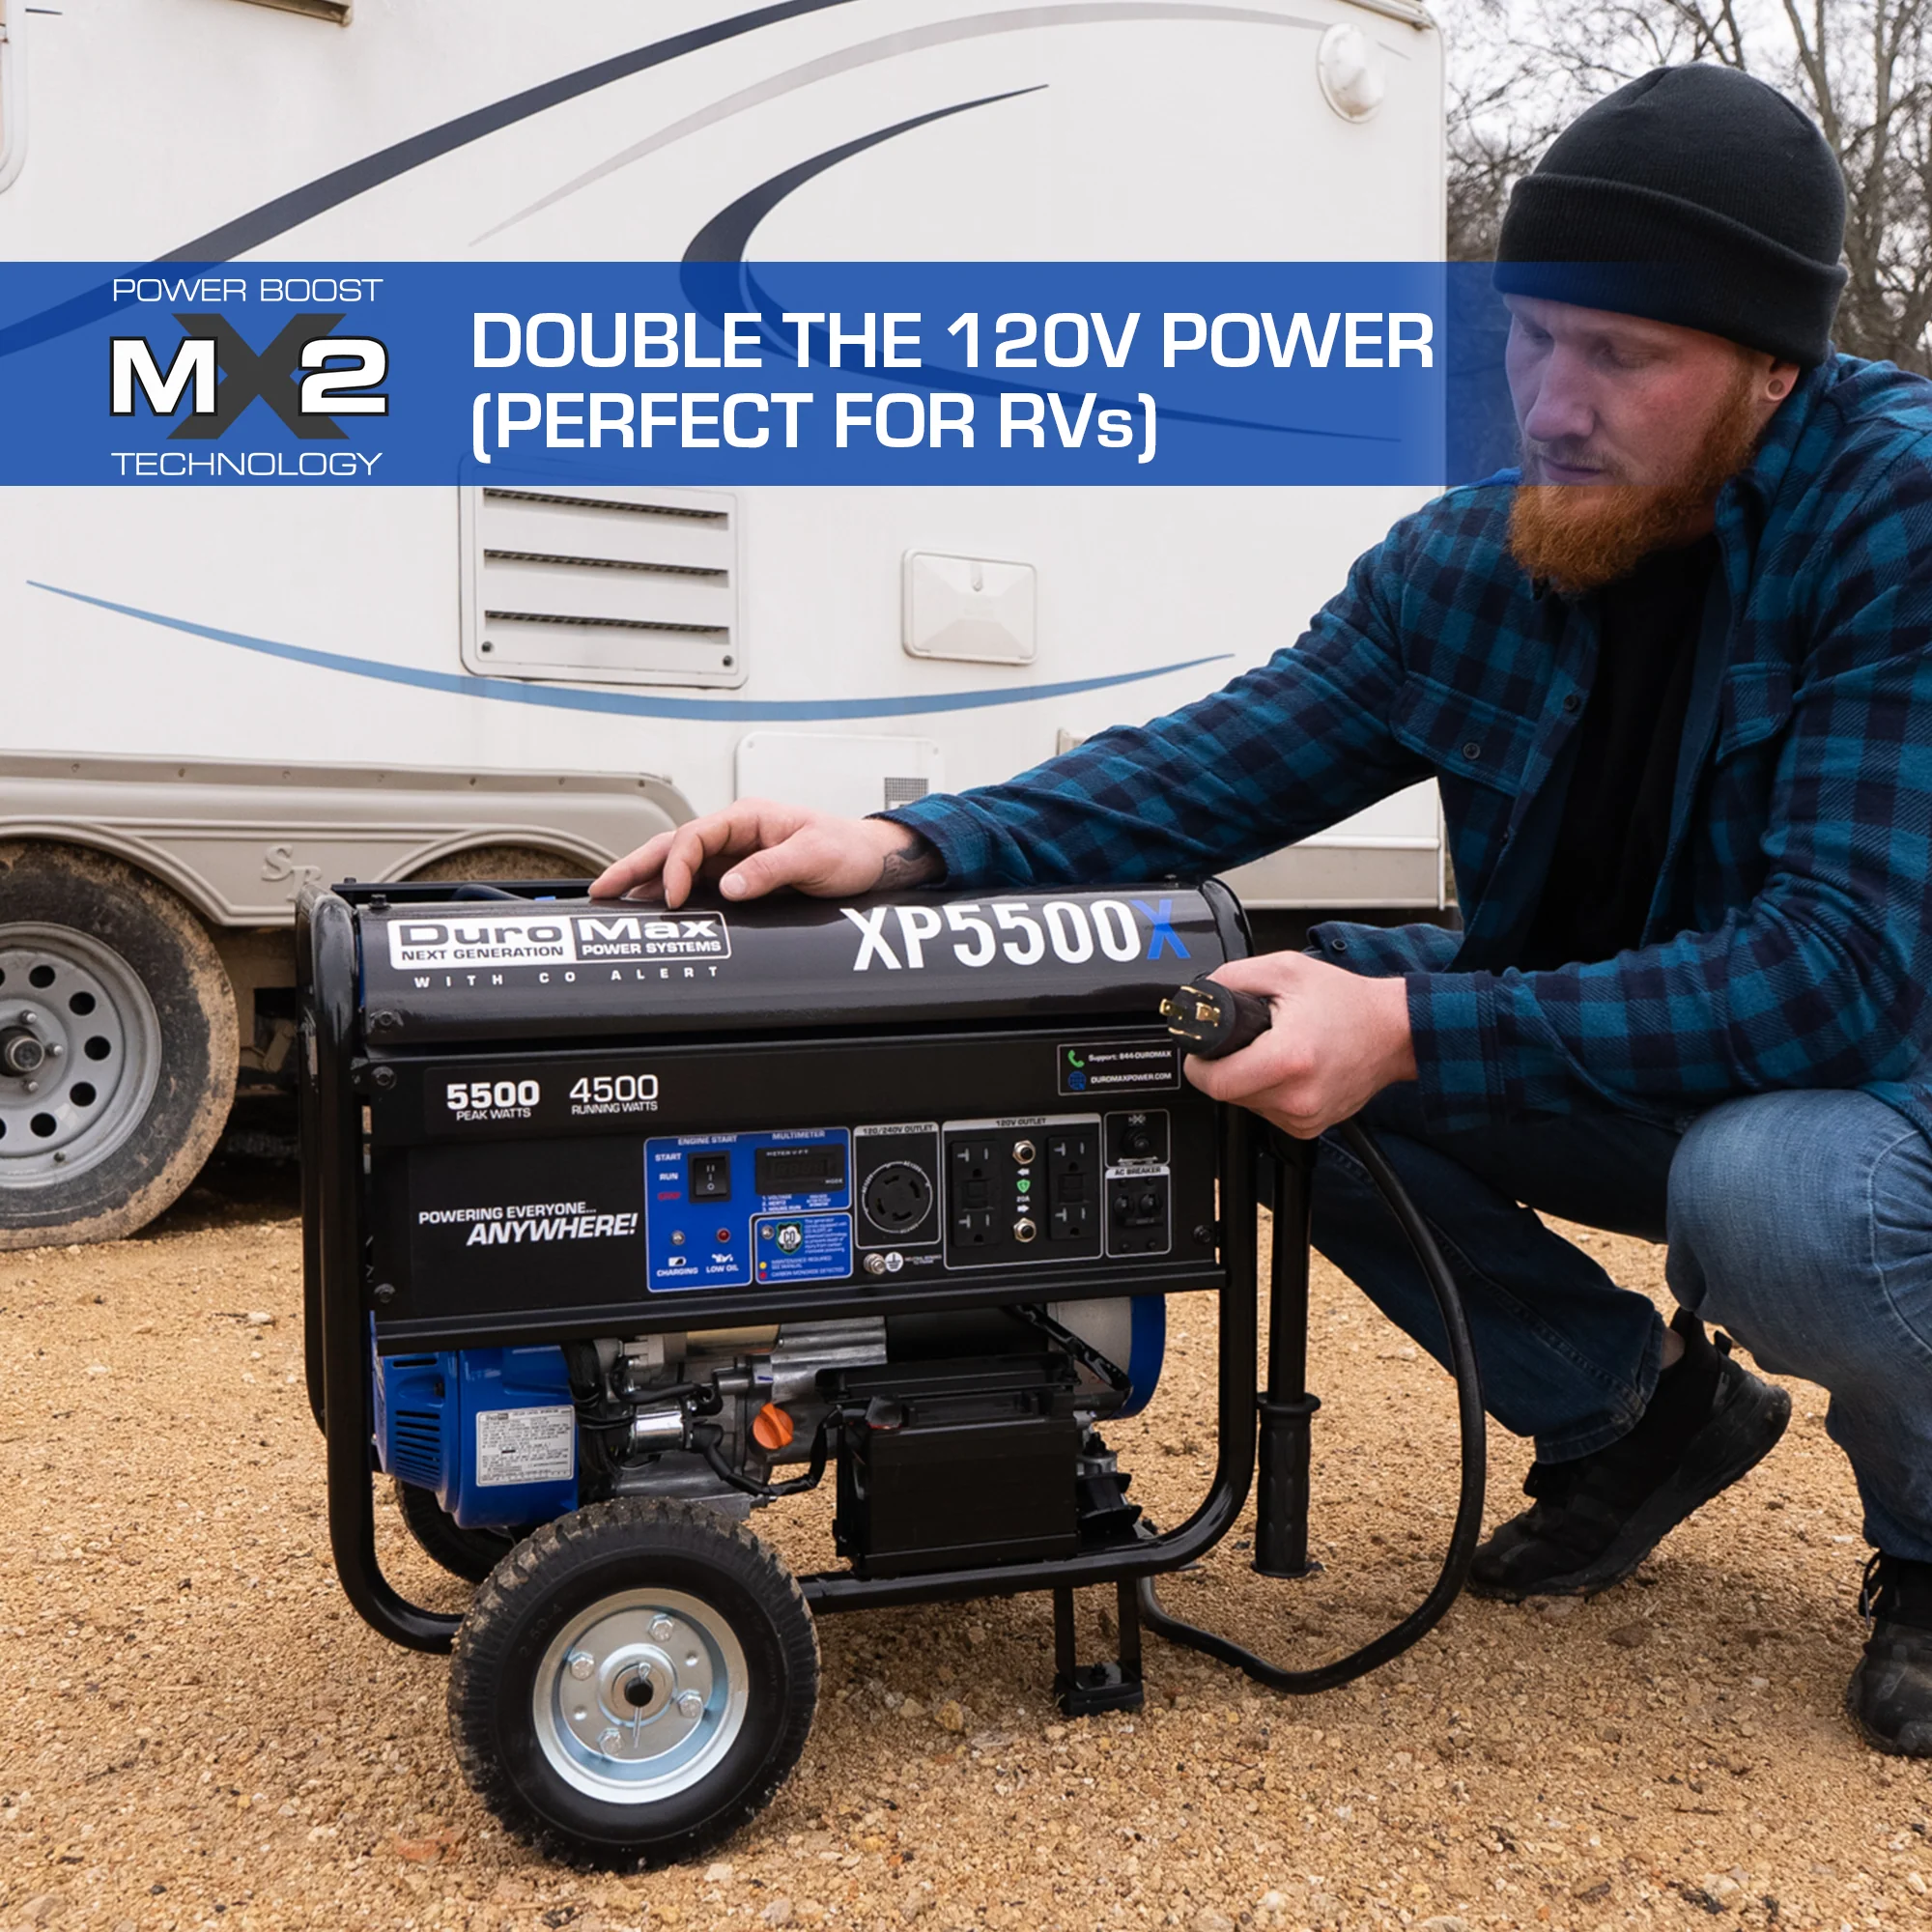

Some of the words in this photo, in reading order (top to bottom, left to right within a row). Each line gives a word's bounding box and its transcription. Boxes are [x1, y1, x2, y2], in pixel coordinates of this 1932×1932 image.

[398, 922, 563, 947] Duro
[579, 916, 719, 941] Max
[839, 898, 1191, 971] XP5500X
[401, 949, 447, 961] NEXT
[452, 946, 564, 959] GENERATION
[582, 943, 642, 955] POWER
[645, 940, 722, 953] SYSTEMS
[413, 974, 503, 988] WITH
[538, 970, 577, 983] CO
[610, 966, 719, 980] ALERT
[1088, 1053, 1118, 1063] Support:
[1091, 1072, 1173, 1084] DUROMAXPOWER.COM
[445, 1079, 541, 1111] 5500
[568, 1073, 660, 1104] 4500
[571, 1102, 621, 1116] RUNNING
[622, 1100, 659, 1113] WATTS
[456, 1110, 488, 1122] PEAK
[490, 1107, 532, 1120] WATTS
[1017, 1117, 1046, 1125] OUTLET
[905, 1124, 933, 1133] OUTLET
[678, 1136, 710, 1146] ENGINE
[711, 1134, 738, 1144] START
[772, 1130, 826, 1141] MULTIMETER
[655, 1152, 682, 1162] START
[659, 1172, 679, 1181] RUN
[1114, 1168, 1125, 1177] AC
[418, 1207, 503, 1224] POWERING
[506, 1202, 597, 1219] EVERYONE...
[465, 1212, 639, 1246] ANYWHERE!
[783, 1230, 796, 1244] CO
[657, 1266, 698, 1277] CHARGING
[706, 1264, 724, 1274] LOW
[725, 1263, 740, 1272] OIL
